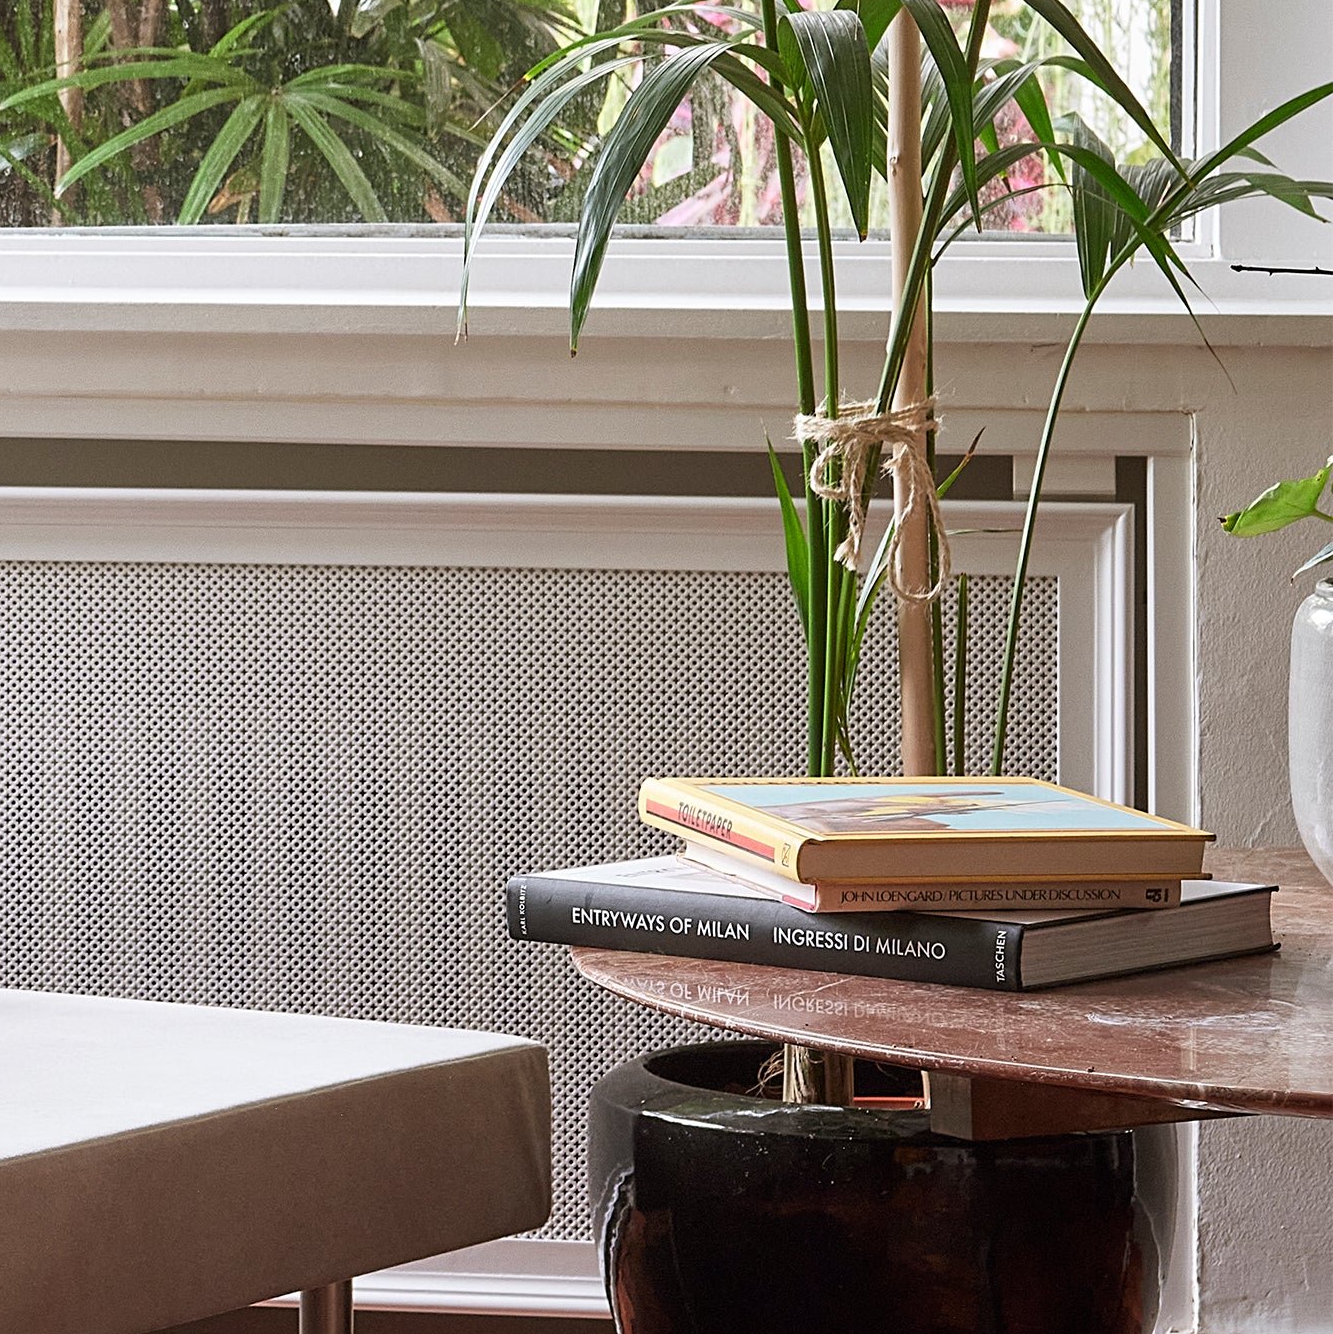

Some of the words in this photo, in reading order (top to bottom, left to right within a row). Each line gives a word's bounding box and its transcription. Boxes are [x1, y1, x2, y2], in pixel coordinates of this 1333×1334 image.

[677, 801, 734, 840] TOILETPAPER
[519, 884, 528, 916] KOLBITZ
[840, 889, 875, 904] JOHN
[948, 888, 1004, 902] PICTURES
[1006, 888, 1048, 901] UNDER
[1049, 887, 1121, 902] DISCUSSION
[520, 916, 528, 936] KARL
[571, 907, 665, 934] ENTRYWAYS
[669, 916, 693, 936] OF
[696, 919, 750, 941] MILAN
[772, 926, 849, 952] INGRESSI
[853, 934, 871, 953] DI
[875, 936, 947, 961] MILANO
[994, 929, 1008, 983] TASCHEN
